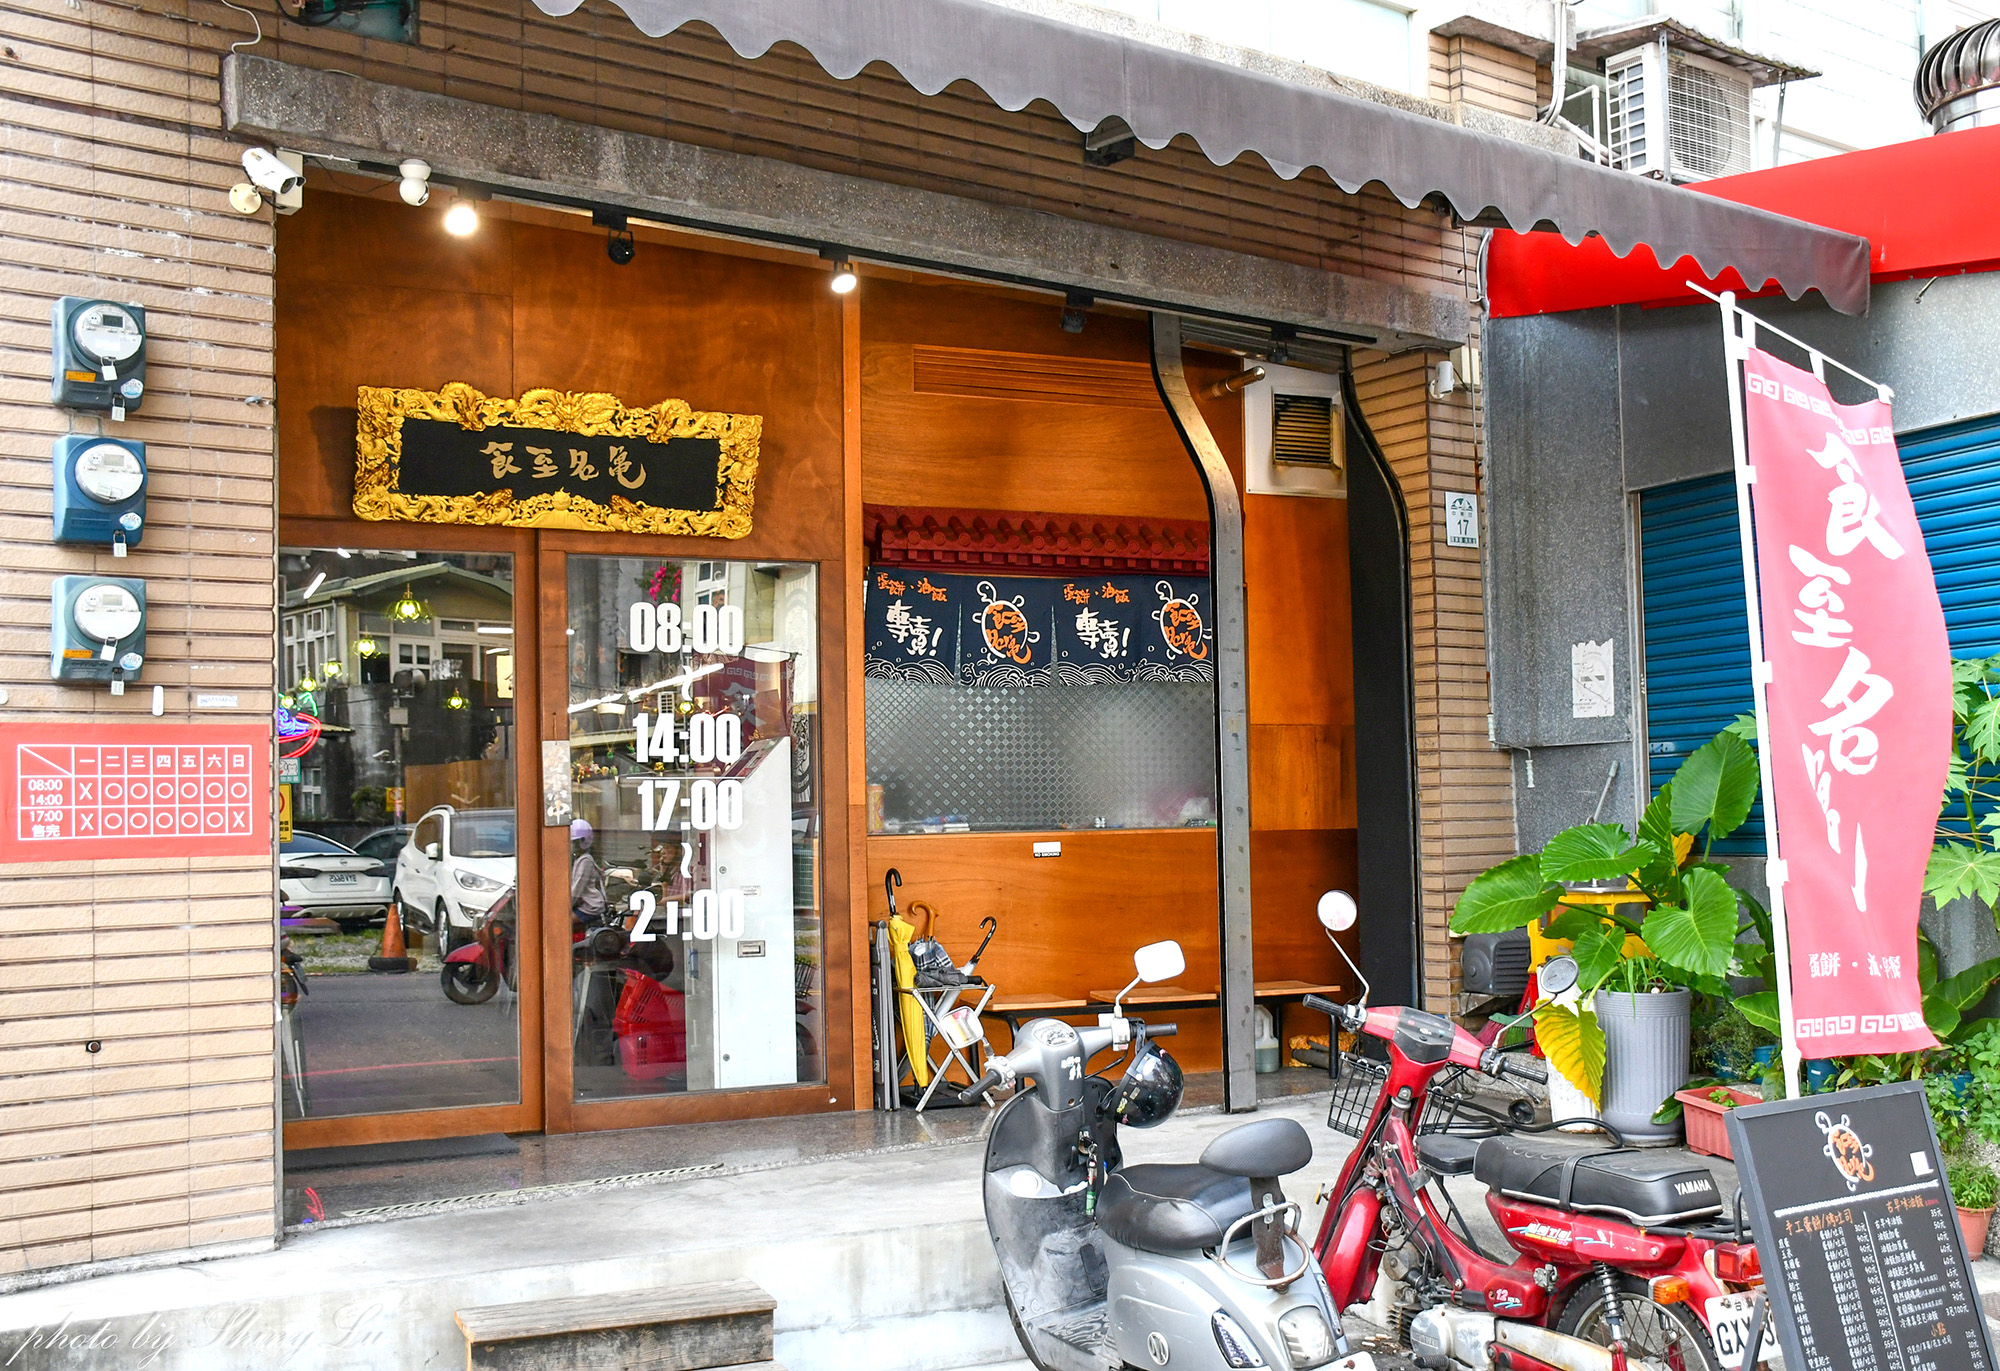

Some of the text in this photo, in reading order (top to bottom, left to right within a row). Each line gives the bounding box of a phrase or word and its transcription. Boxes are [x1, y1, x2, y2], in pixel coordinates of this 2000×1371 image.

[1457, 519, 1469, 536] 17
[629, 602, 743, 653] 08:00
[632, 712, 742, 763] 14:00
[105, 755, 120, 767] 二
[131, 755, 146, 768] 三
[156, 755, 171, 768] 四
[182, 755, 196, 768] 五
[207, 754, 222, 768] 六
[232, 754, 245, 768] 日
[28, 779, 63, 792] 08:00
[29, 794, 63, 806] 14:00
[637, 779, 743, 831] 17:00
[29, 810, 63, 822] 17:00
[1674, 1178, 1713, 1196] YAMAHA
[1496, 1288, 1509, 1301] 12
